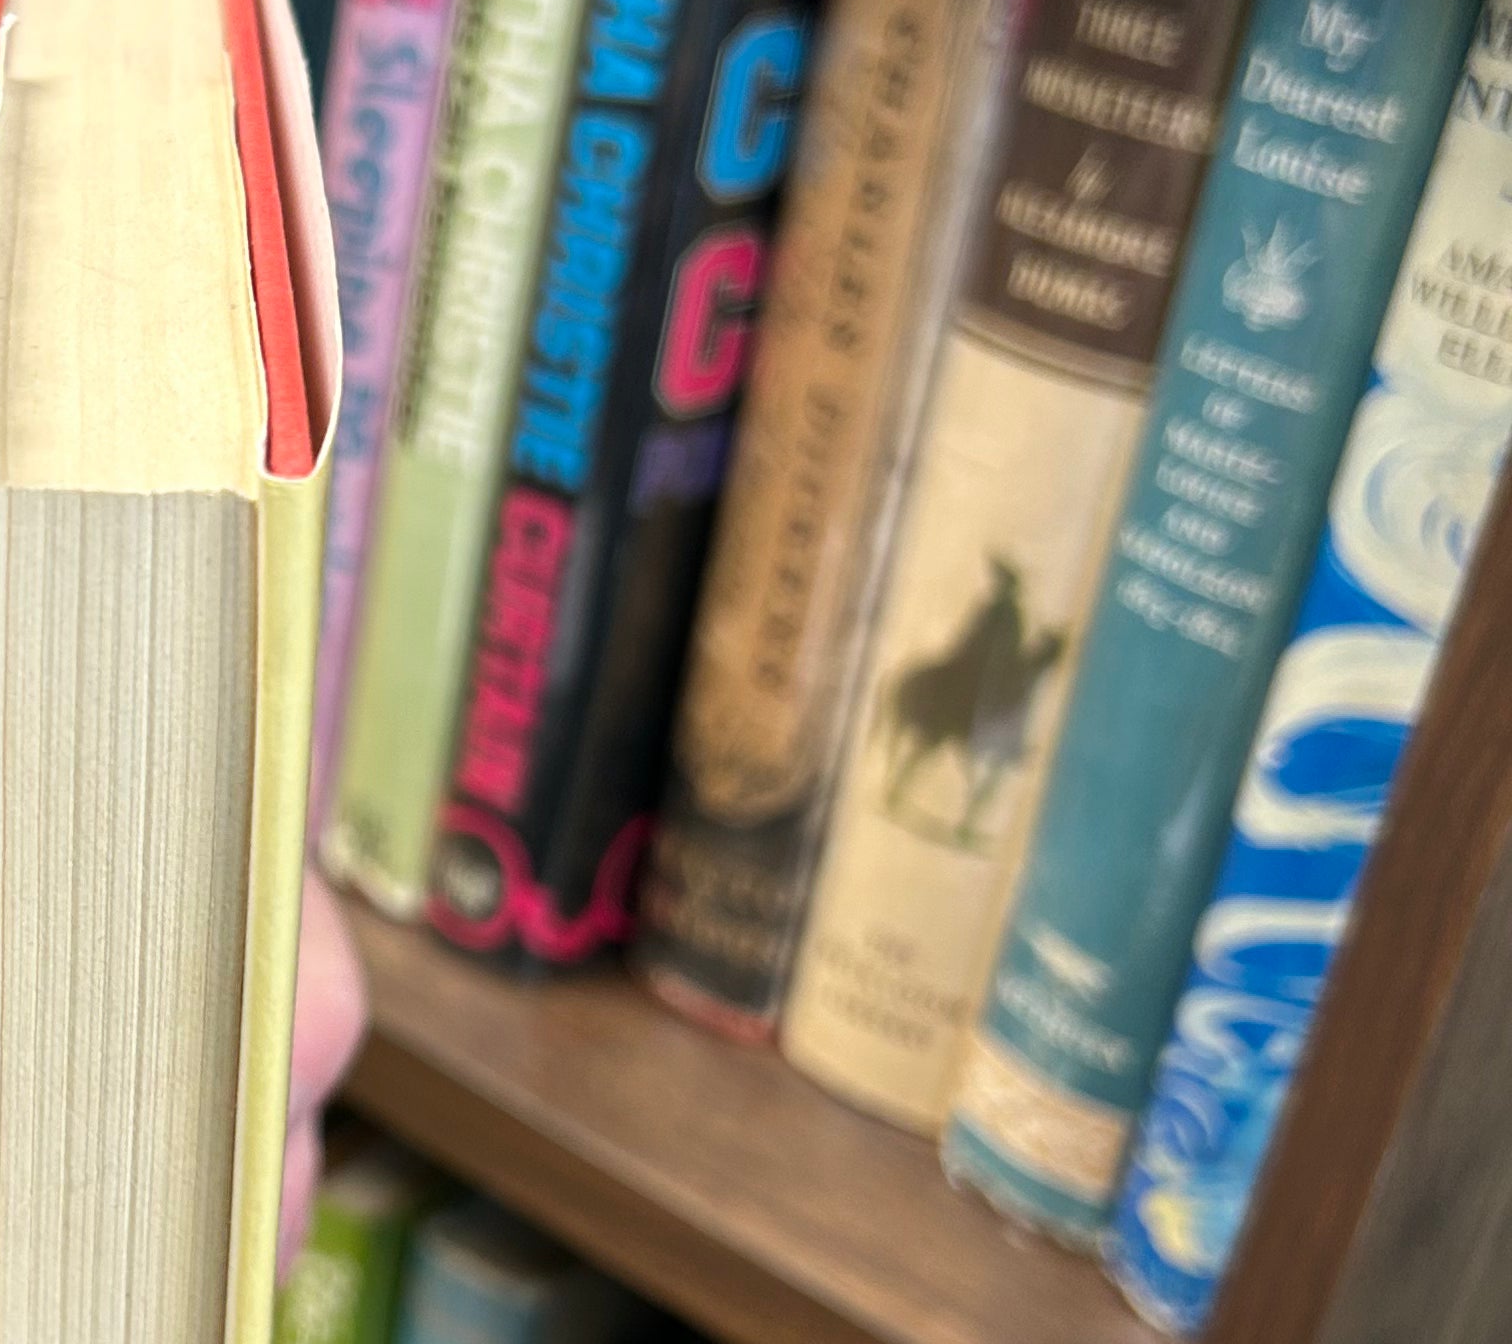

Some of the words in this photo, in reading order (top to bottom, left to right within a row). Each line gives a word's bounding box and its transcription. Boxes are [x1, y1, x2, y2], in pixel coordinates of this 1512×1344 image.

[1235, 118, 1372, 204] Louise
[1243, 50, 1405, 142] Dearest
[422, 149, 533, 475] CHRISTIE
[516, 104, 650, 488] CHRISTIE
